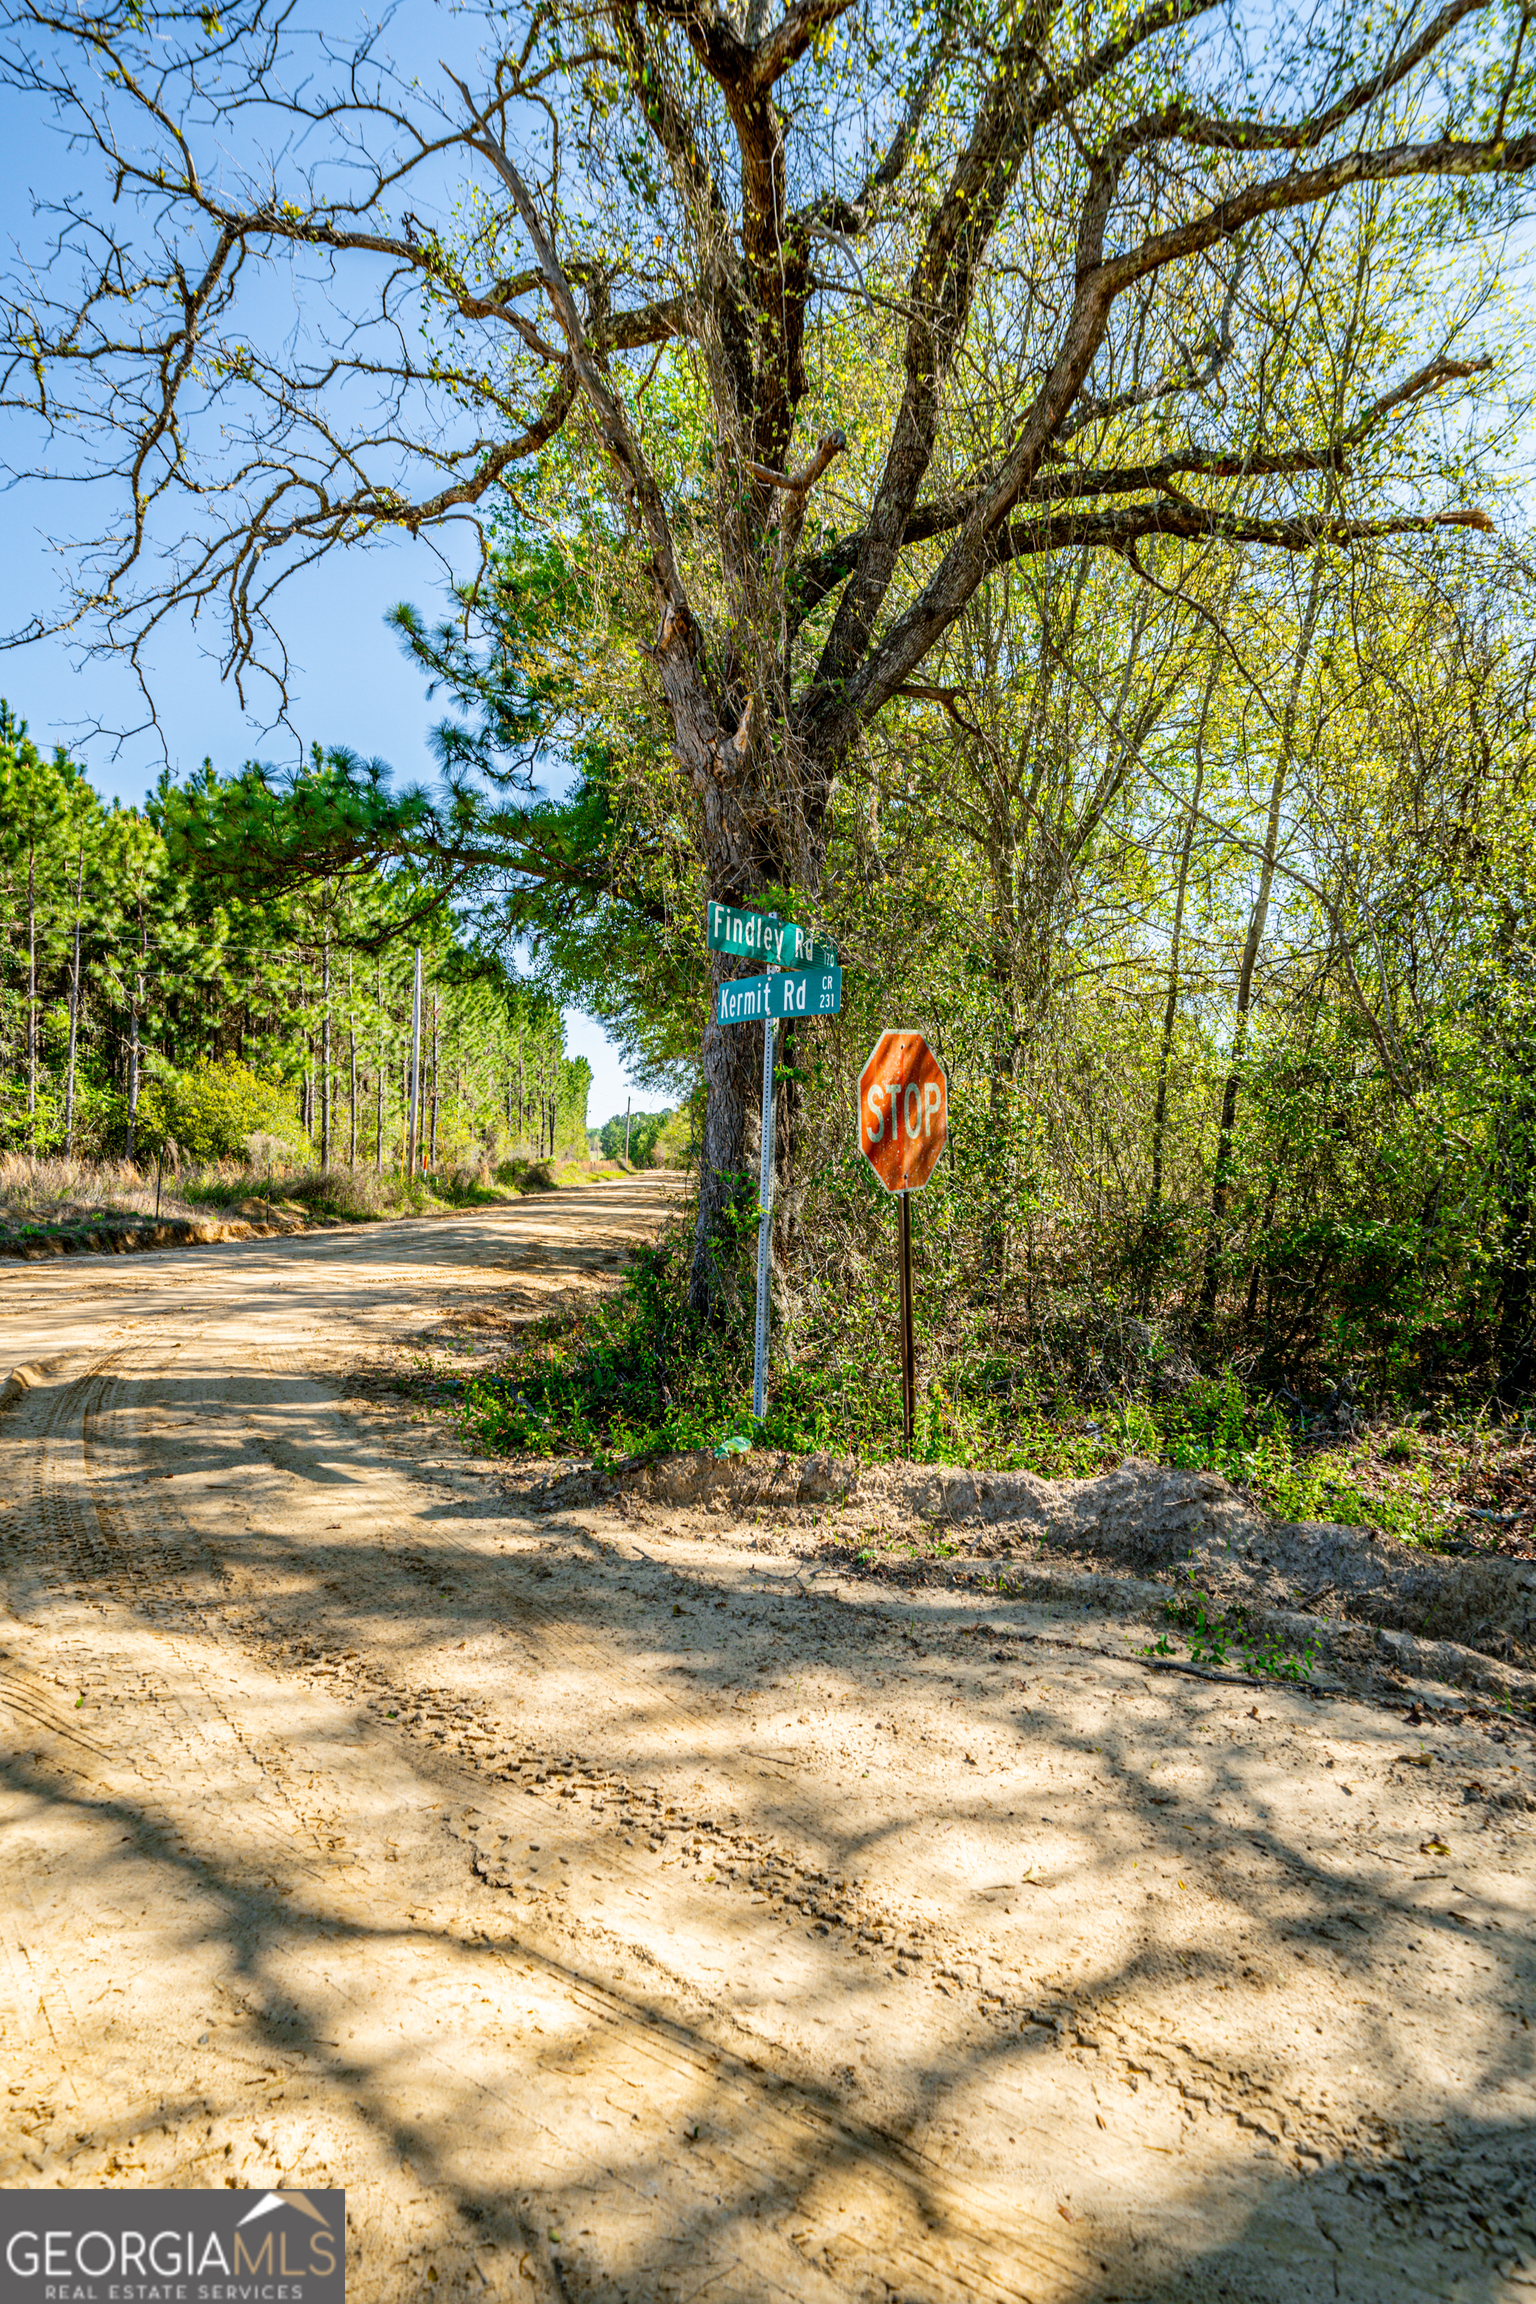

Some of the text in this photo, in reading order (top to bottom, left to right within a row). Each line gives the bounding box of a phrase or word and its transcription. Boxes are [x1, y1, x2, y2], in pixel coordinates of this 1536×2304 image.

[714, 905, 813, 962] Findley Rd
[720, 978, 806, 1019] Kermit Rd
[819, 993, 834, 1009] 231
[822, 976, 833, 990] CR
[866, 1082, 942, 1143] STOP
